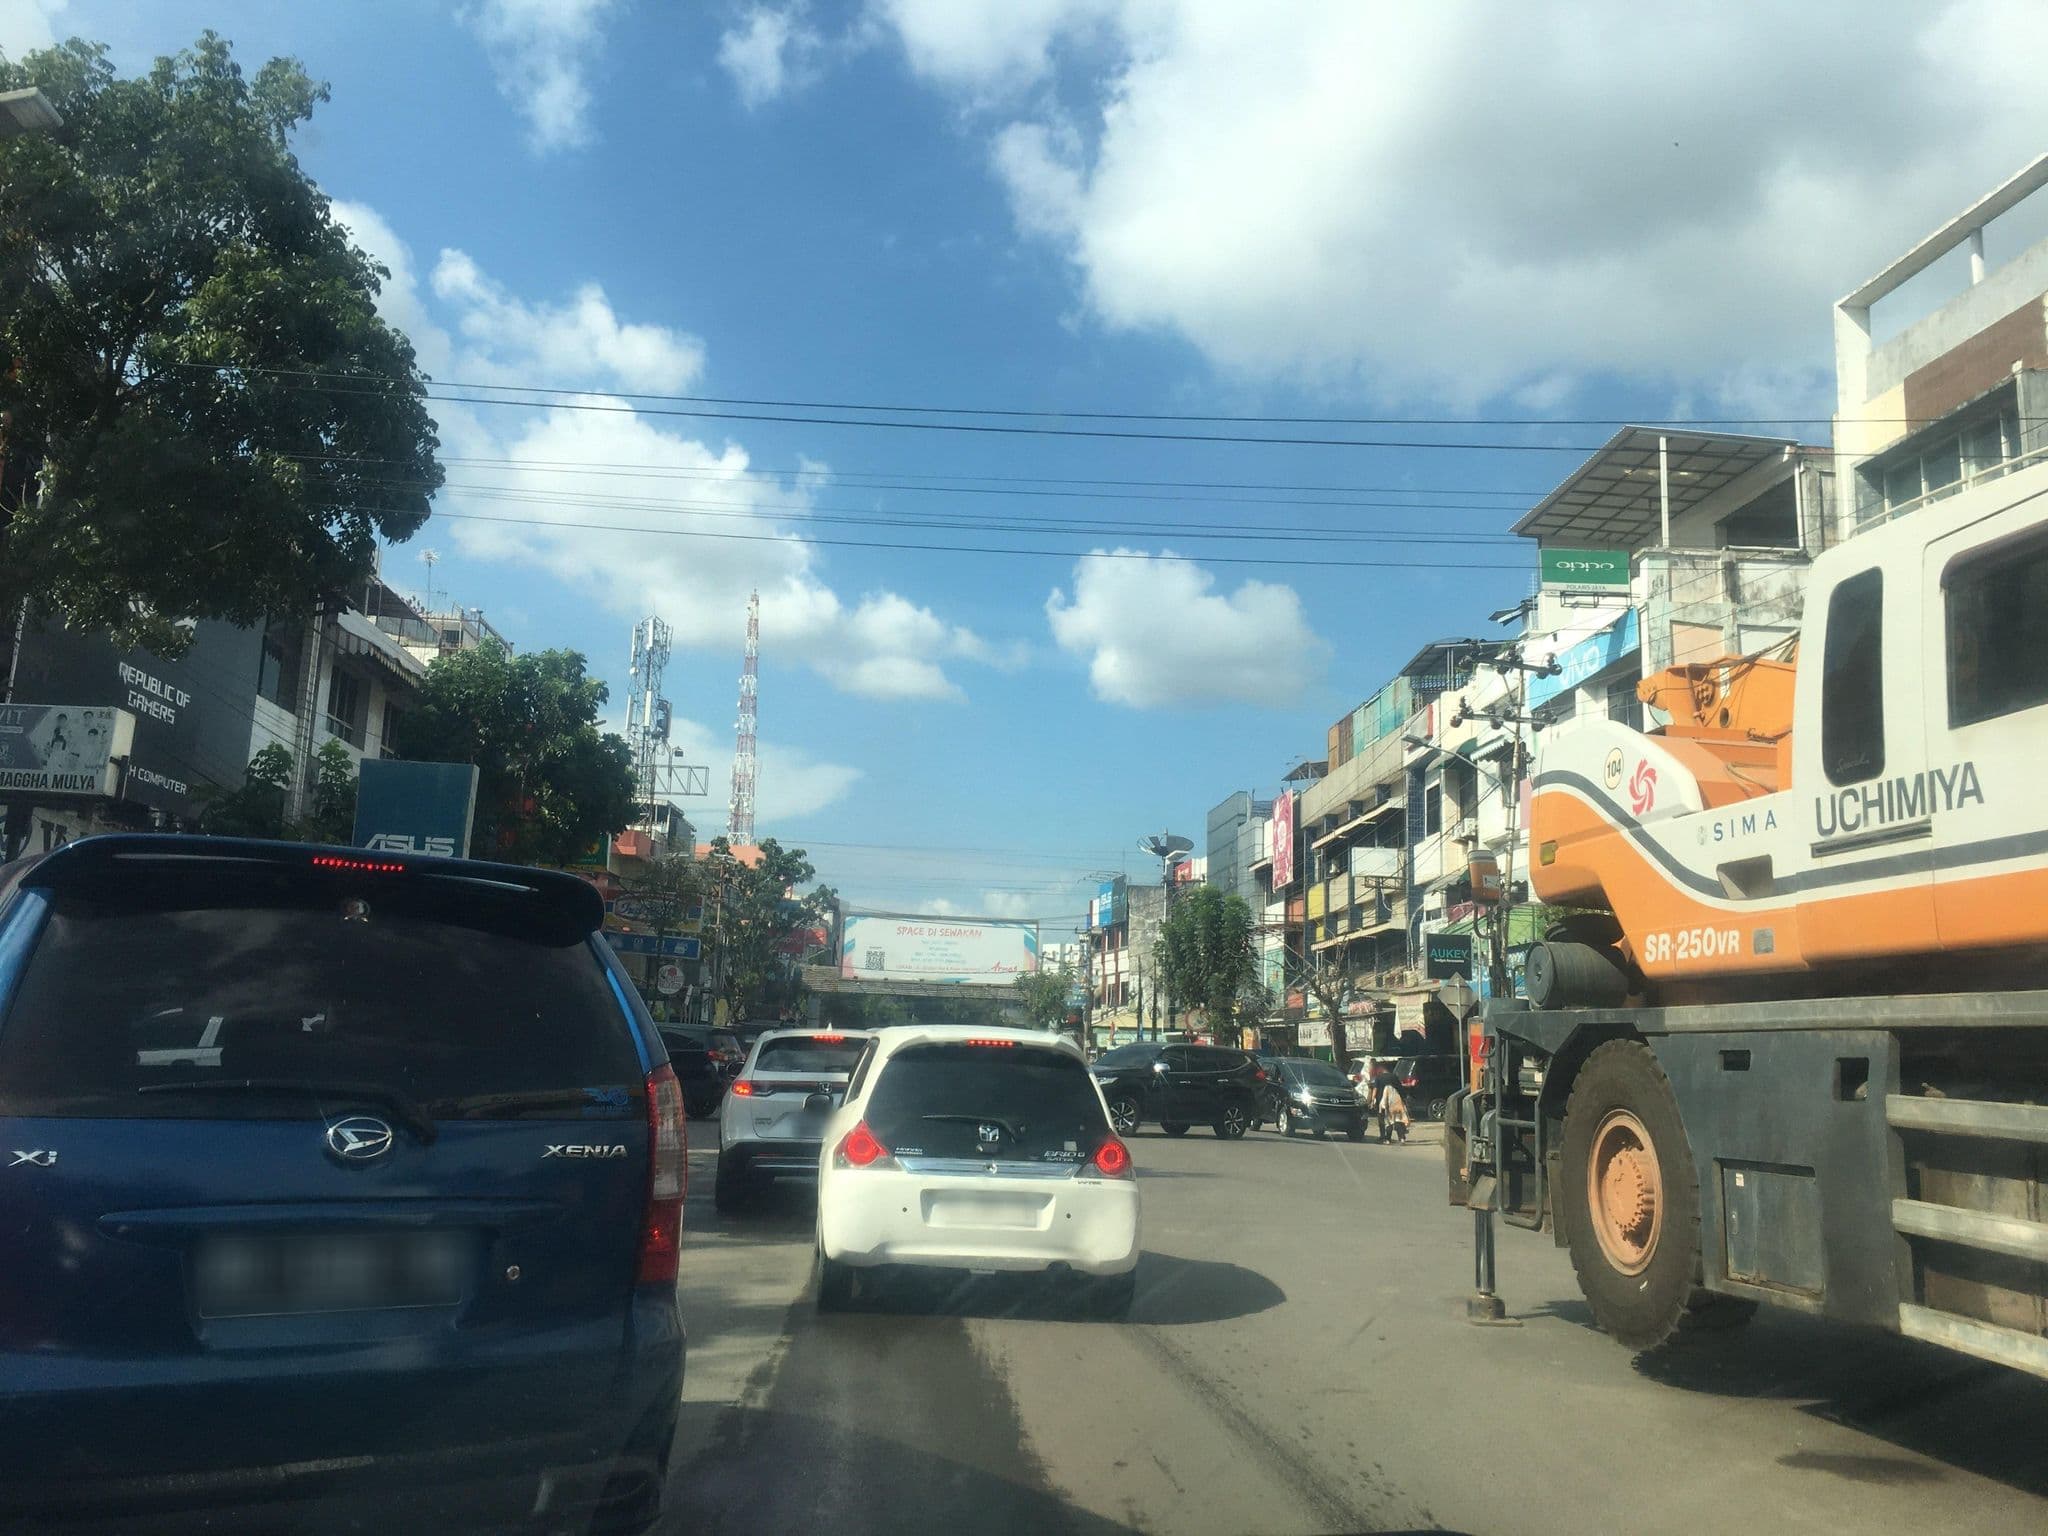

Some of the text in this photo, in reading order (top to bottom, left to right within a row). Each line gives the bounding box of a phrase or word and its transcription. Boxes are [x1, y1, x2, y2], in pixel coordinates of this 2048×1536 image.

[119, 661, 191, 708] REPUBLIC OF
[127, 691, 175, 725] GAMERS
[138, 768, 187, 794] COMPUTER
[1607, 759, 1622, 779] 104
[51, 773, 95, 791] MULYA
[1815, 761, 1984, 836] UCHIMIYA
[1713, 809, 1778, 842] SIMA
[364, 833, 455, 857] ASUS
[896, 926, 982, 937] SPACE DI SEWAKAN
[1431, 948, 1468, 959] AUKEY
[541, 1144, 627, 1158] XENIA
